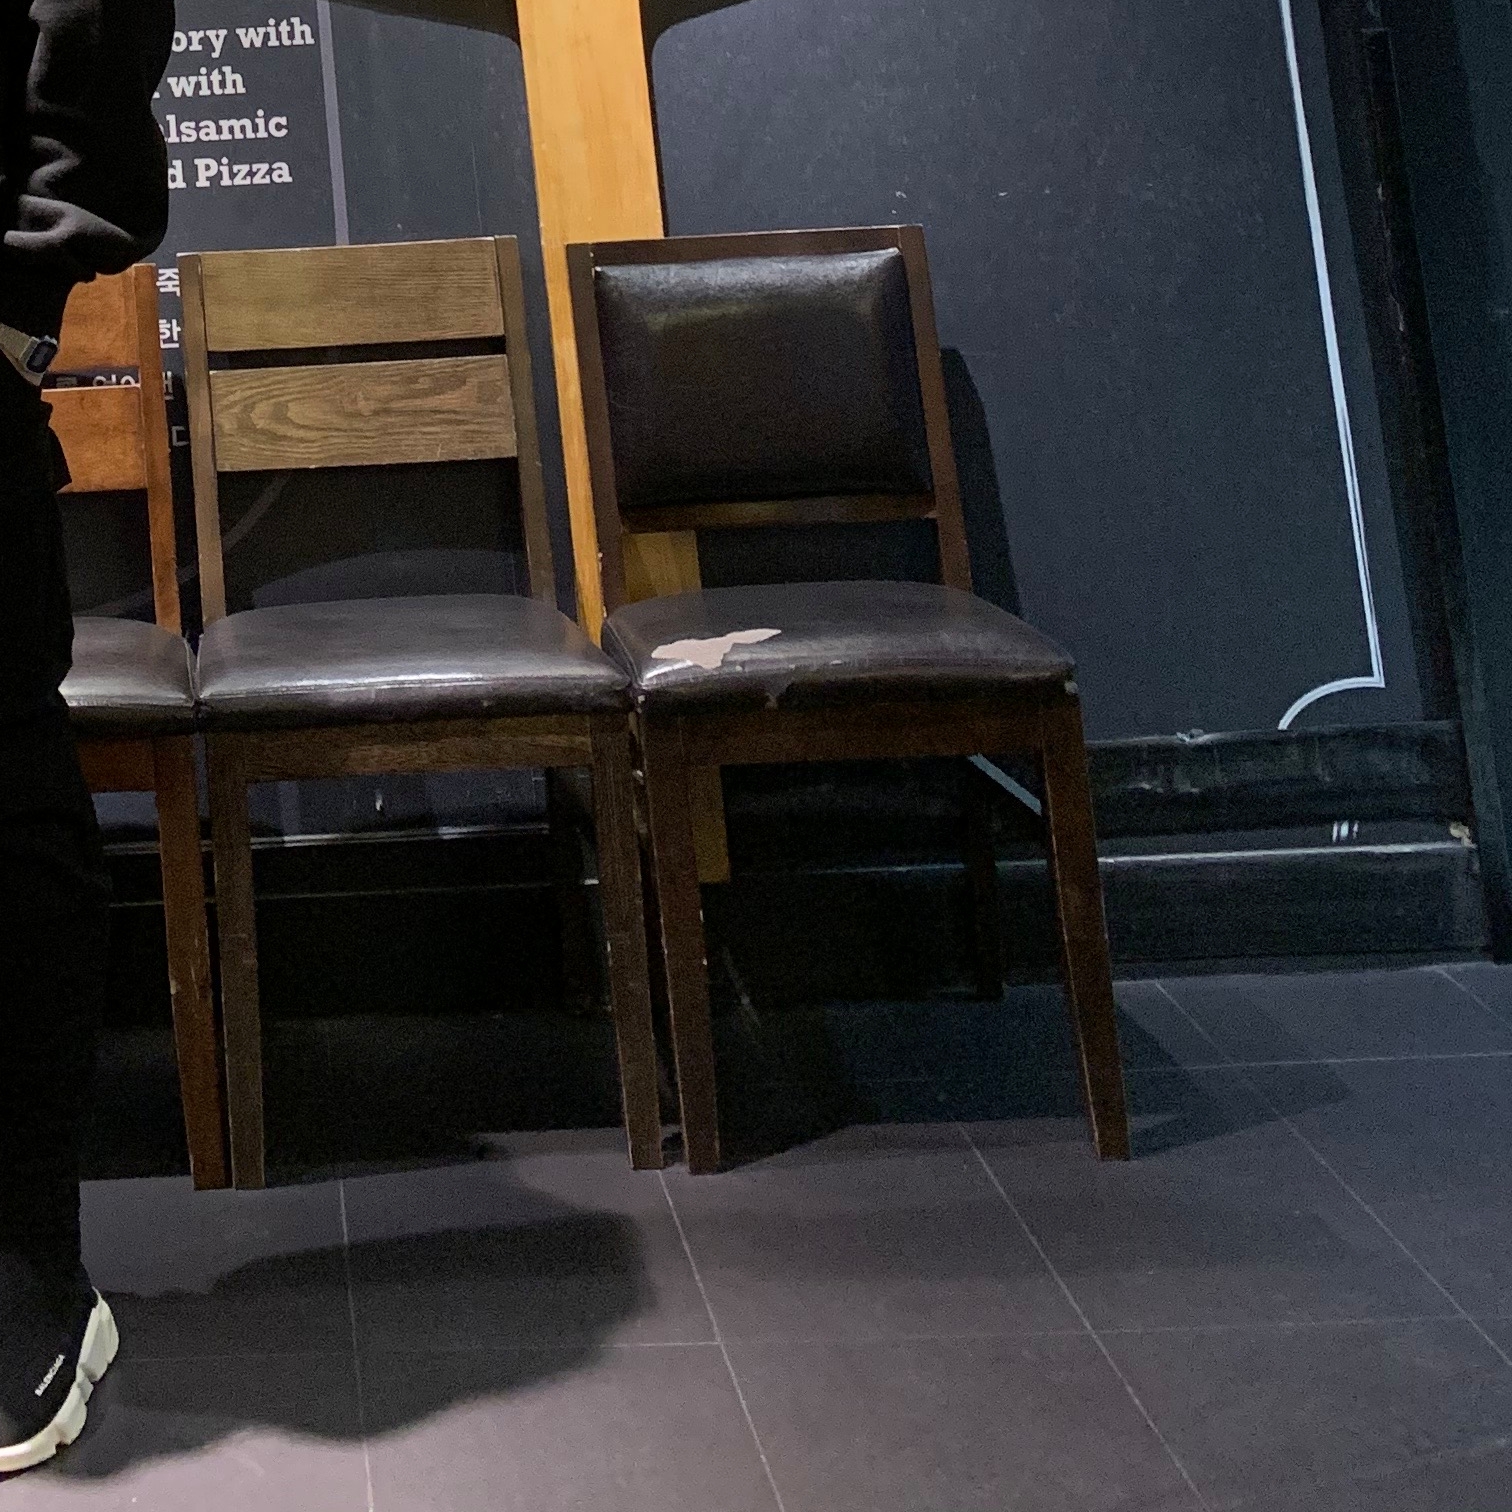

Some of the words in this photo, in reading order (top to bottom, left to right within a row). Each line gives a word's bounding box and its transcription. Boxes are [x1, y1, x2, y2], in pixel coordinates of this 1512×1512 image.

[235, 16, 315, 49] with
[166, 65, 247, 98] with
[193, 156, 293, 188] Pizza
